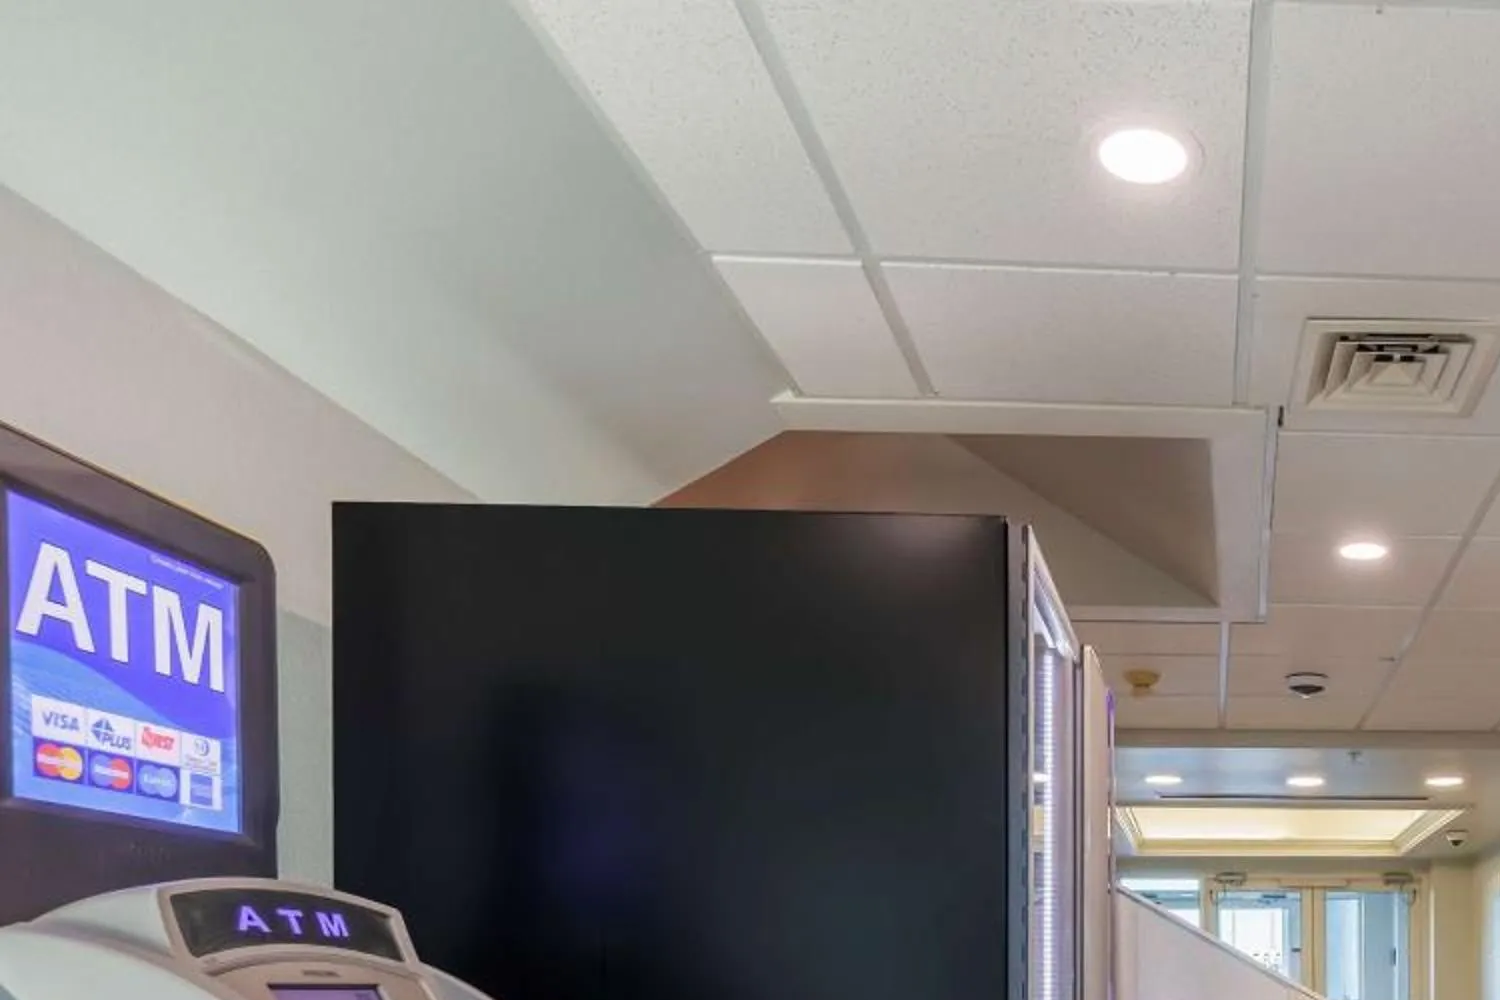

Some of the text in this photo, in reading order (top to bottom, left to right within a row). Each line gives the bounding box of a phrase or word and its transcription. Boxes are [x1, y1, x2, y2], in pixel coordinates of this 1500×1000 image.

[16, 541, 225, 693] ATM
[42, 711, 81, 732] VISA
[102, 731, 131, 751] PLUS
[237, 905, 350, 938] ATM
